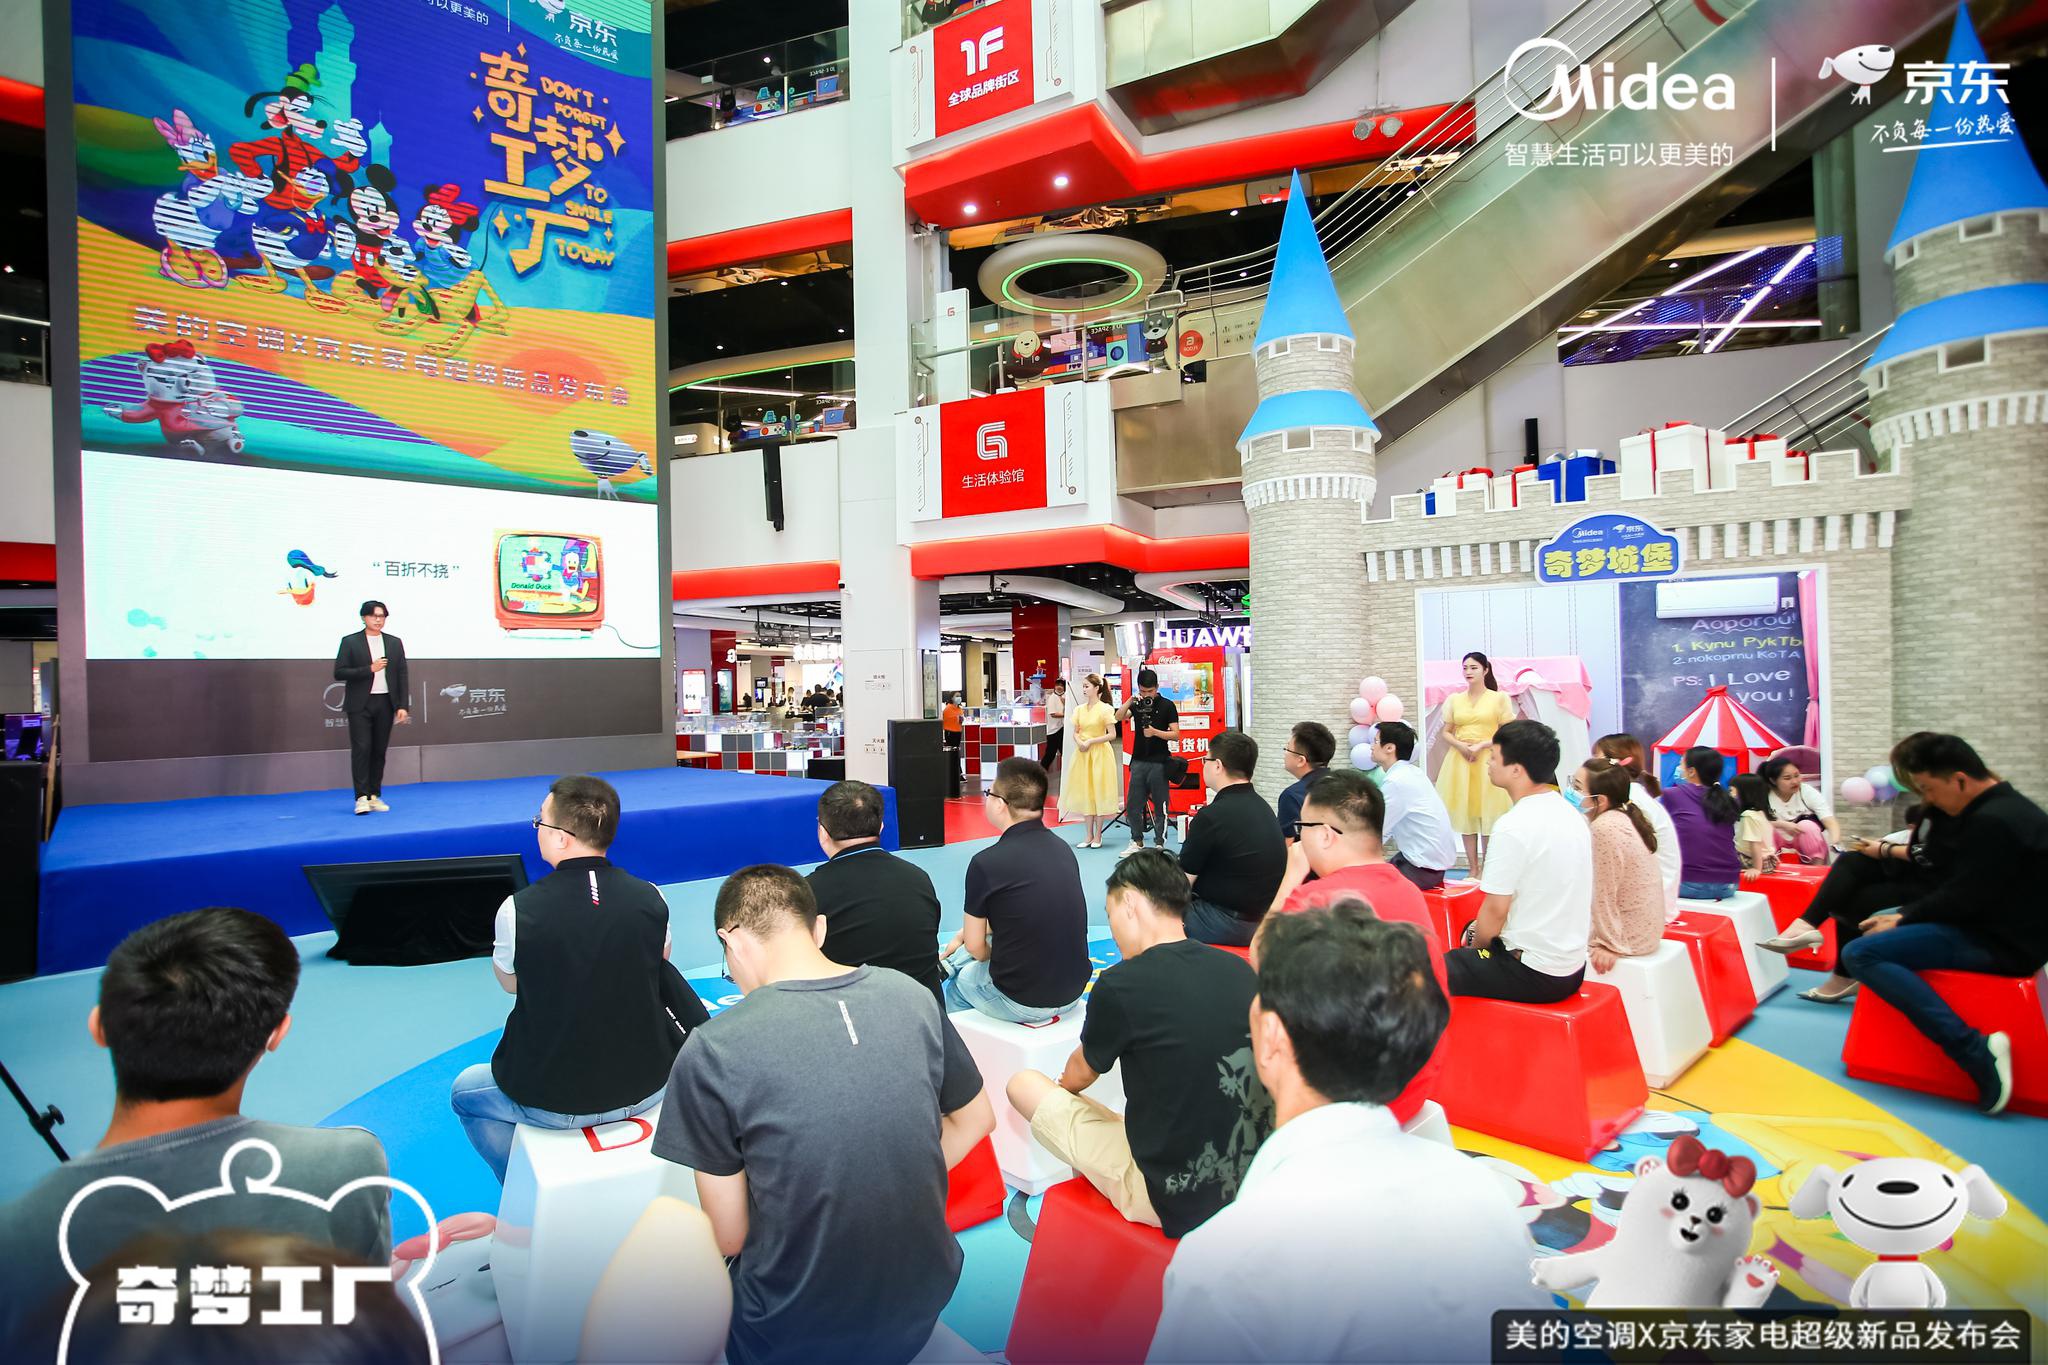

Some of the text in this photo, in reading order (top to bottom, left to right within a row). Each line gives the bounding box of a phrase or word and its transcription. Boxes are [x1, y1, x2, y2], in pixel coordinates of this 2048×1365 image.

[568, 10, 618, 47] 京东
[961, 26, 1004, 76] 1F
[540, 76, 594, 108] DON'T
[948, 69, 1020, 108] 全球品牌街区
[555, 102, 607, 130] FORGET
[583, 183, 608, 203] TO
[564, 200, 613, 224] SMILE
[555, 238, 616, 266] TODAY
[961, 468, 1025, 489] 生活体验馆
[1571, 527, 1604, 539] Midea
[1543, 541, 1674, 578] 奇梦城堡
[511, 582, 534, 590] Donald
[1727, 670, 1791, 686] Love
[469, 688, 506, 703] 京东
